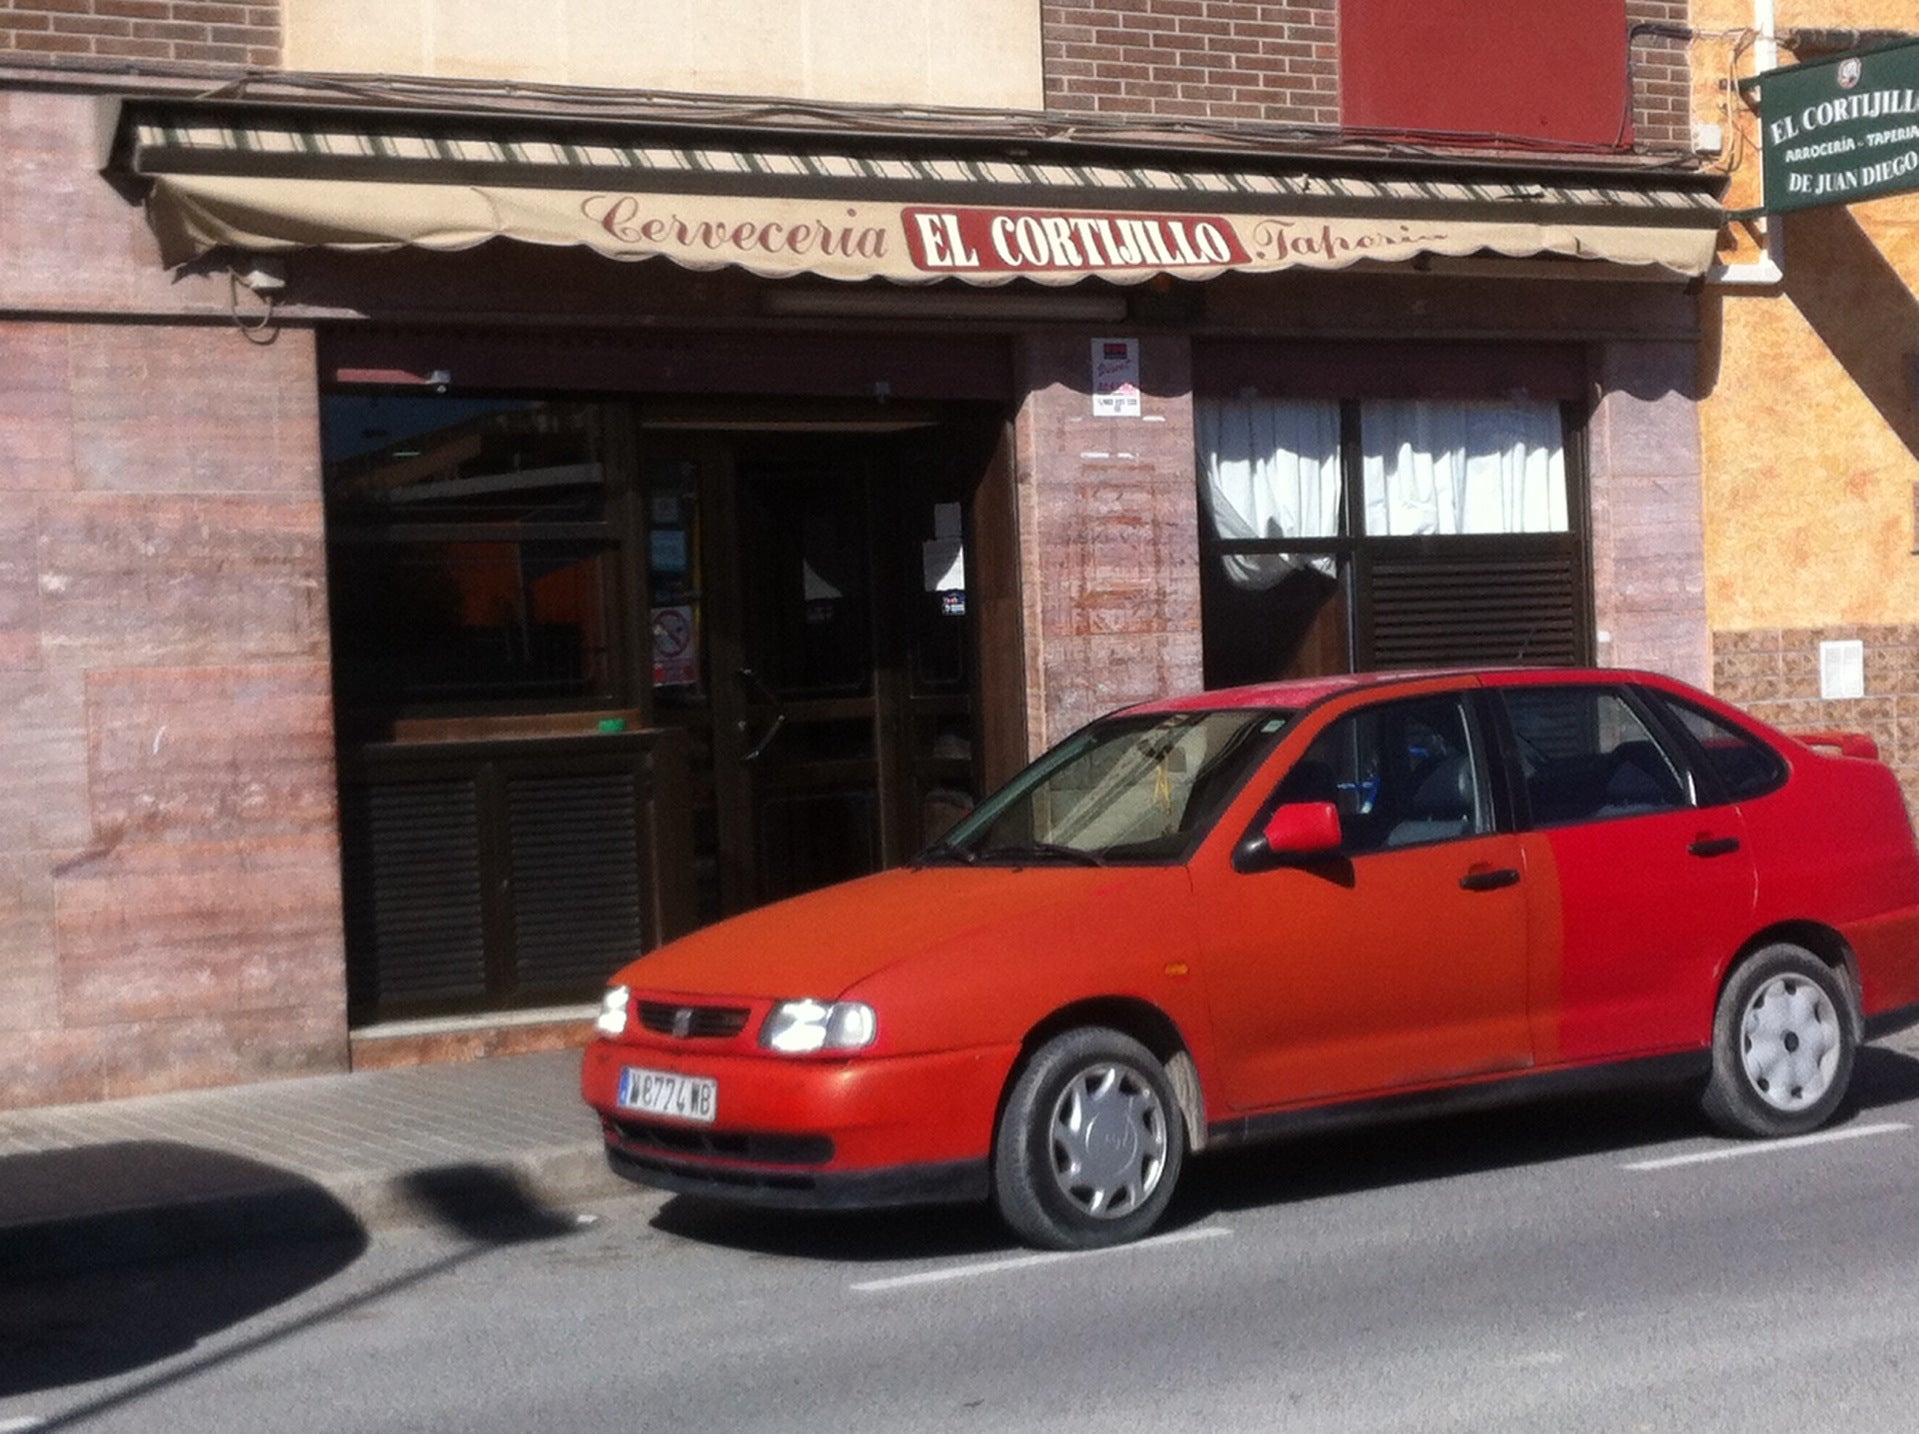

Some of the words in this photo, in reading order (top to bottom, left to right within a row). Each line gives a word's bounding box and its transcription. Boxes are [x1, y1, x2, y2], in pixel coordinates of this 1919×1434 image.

[1769, 115, 1799, 146] EL
[1802, 88, 1919, 131] CORTIJILL
[1788, 172, 1814, 193] DE
[1815, 170, 1858, 195] JUAN
[1861, 150, 1919, 187] DIEGO
[913, 212, 980, 268] EL
[990, 214, 1233, 268] CORTIJILLO
